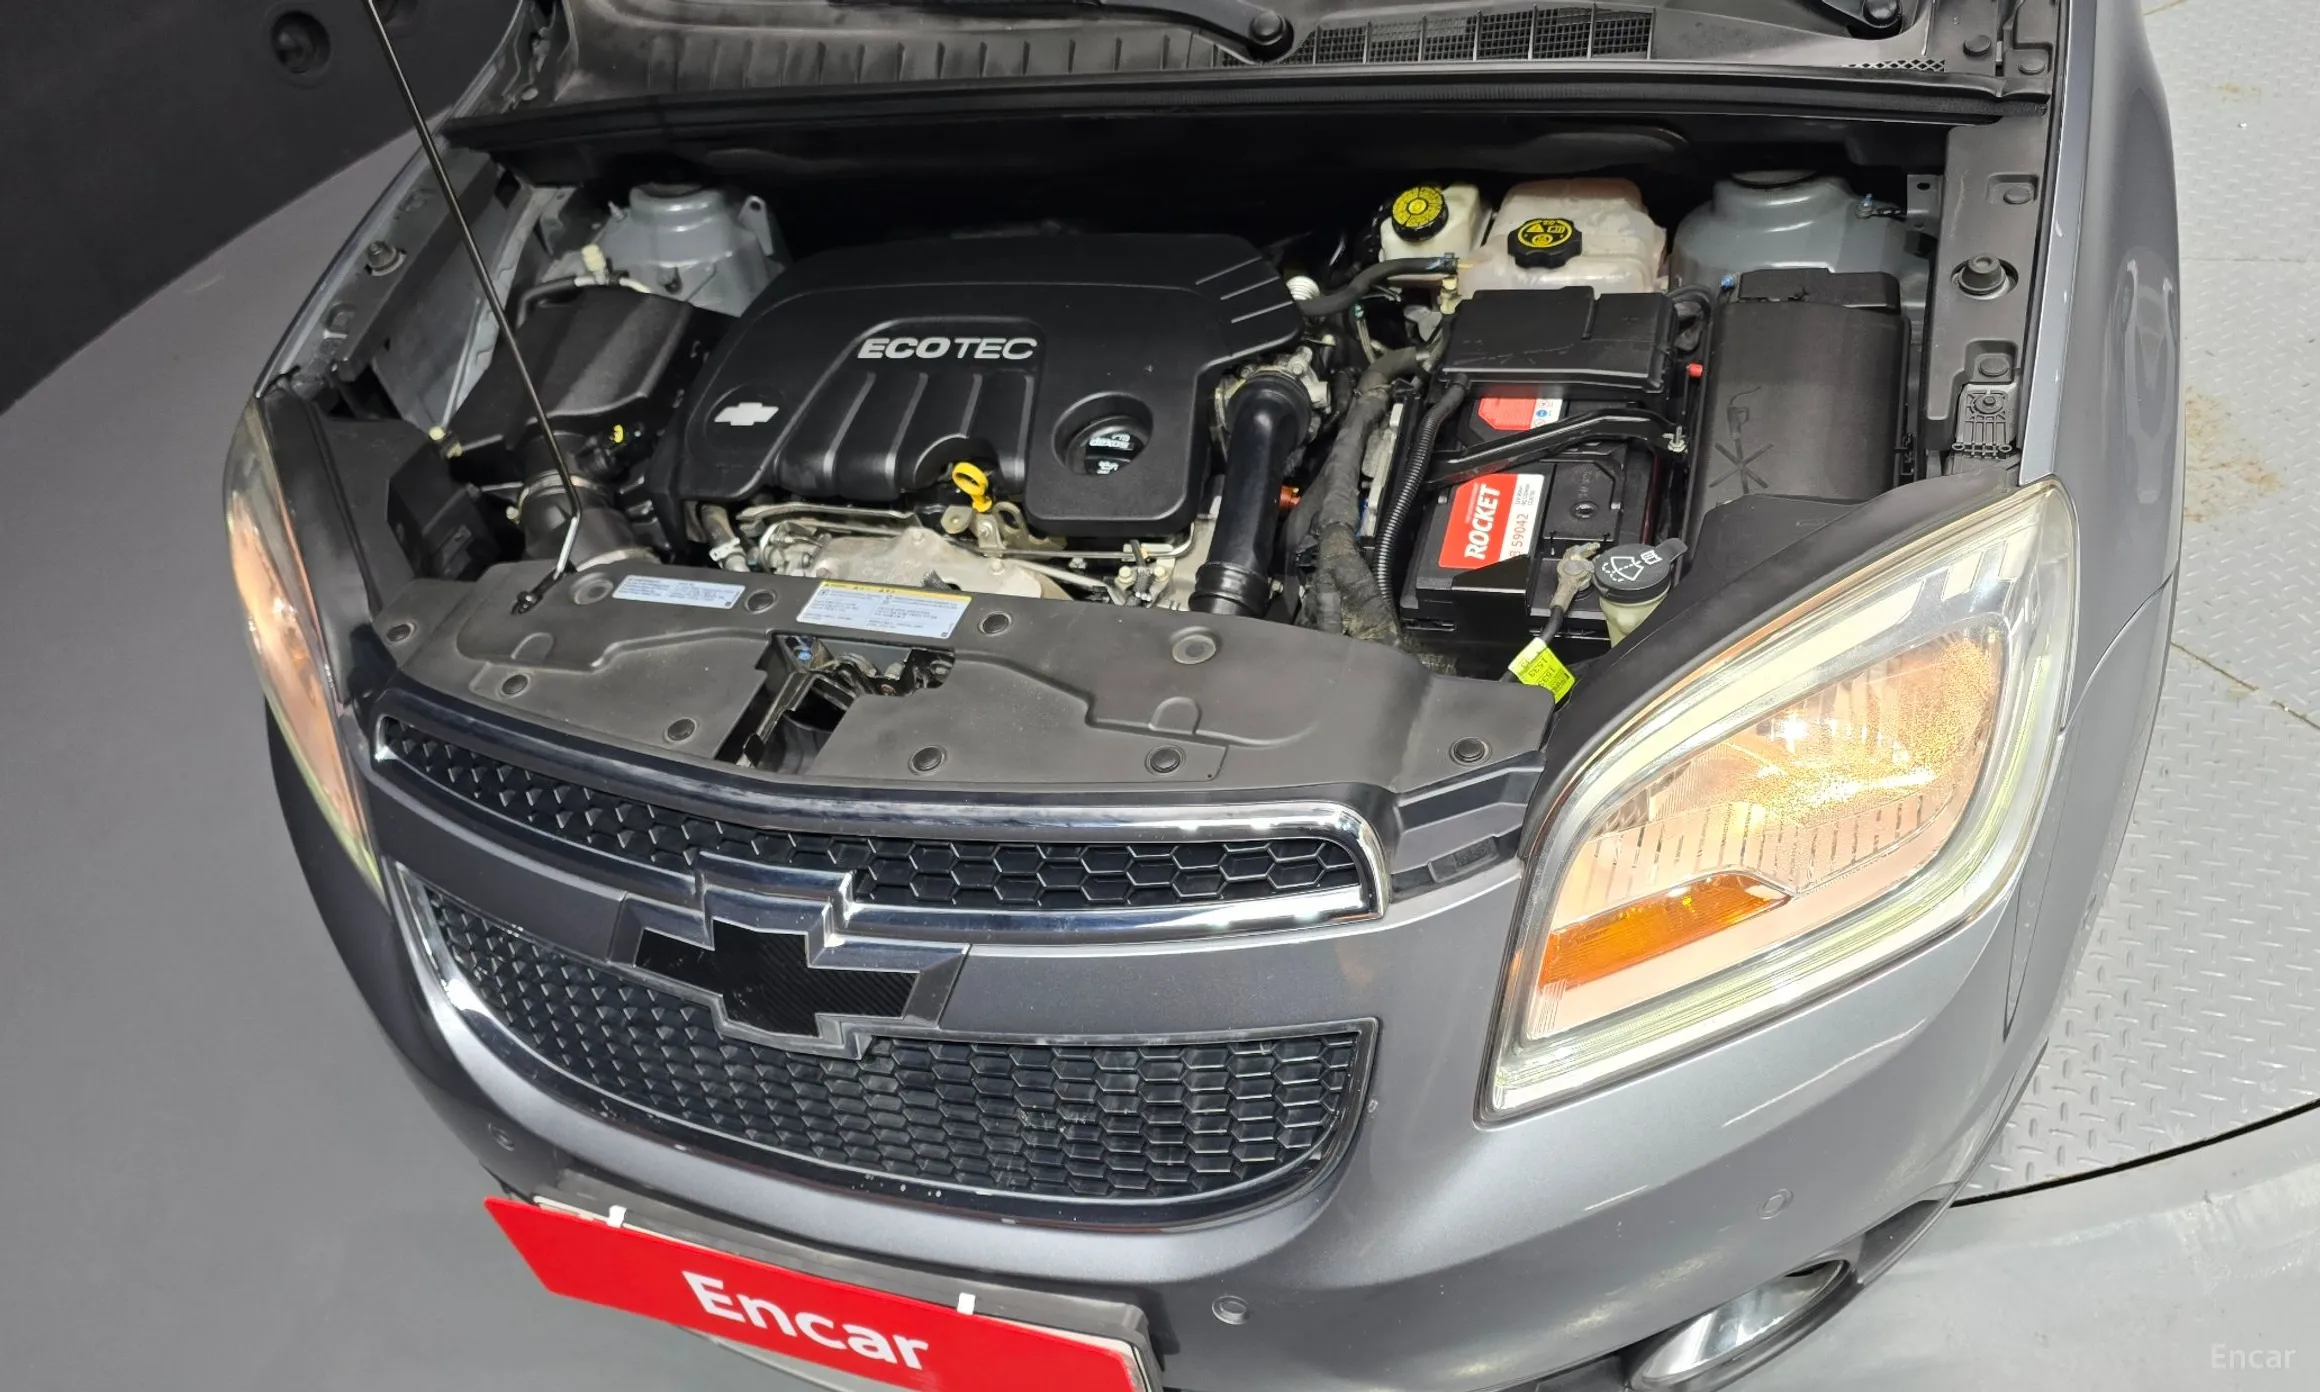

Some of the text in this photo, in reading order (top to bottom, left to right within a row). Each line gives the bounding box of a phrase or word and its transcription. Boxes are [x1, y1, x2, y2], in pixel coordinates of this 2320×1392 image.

[858, 337, 1037, 360] ECOTEC
[1464, 483, 1501, 560] ROCKET
[1511, 513, 1529, 547] 59042
[681, 1270, 929, 1370] Encar
